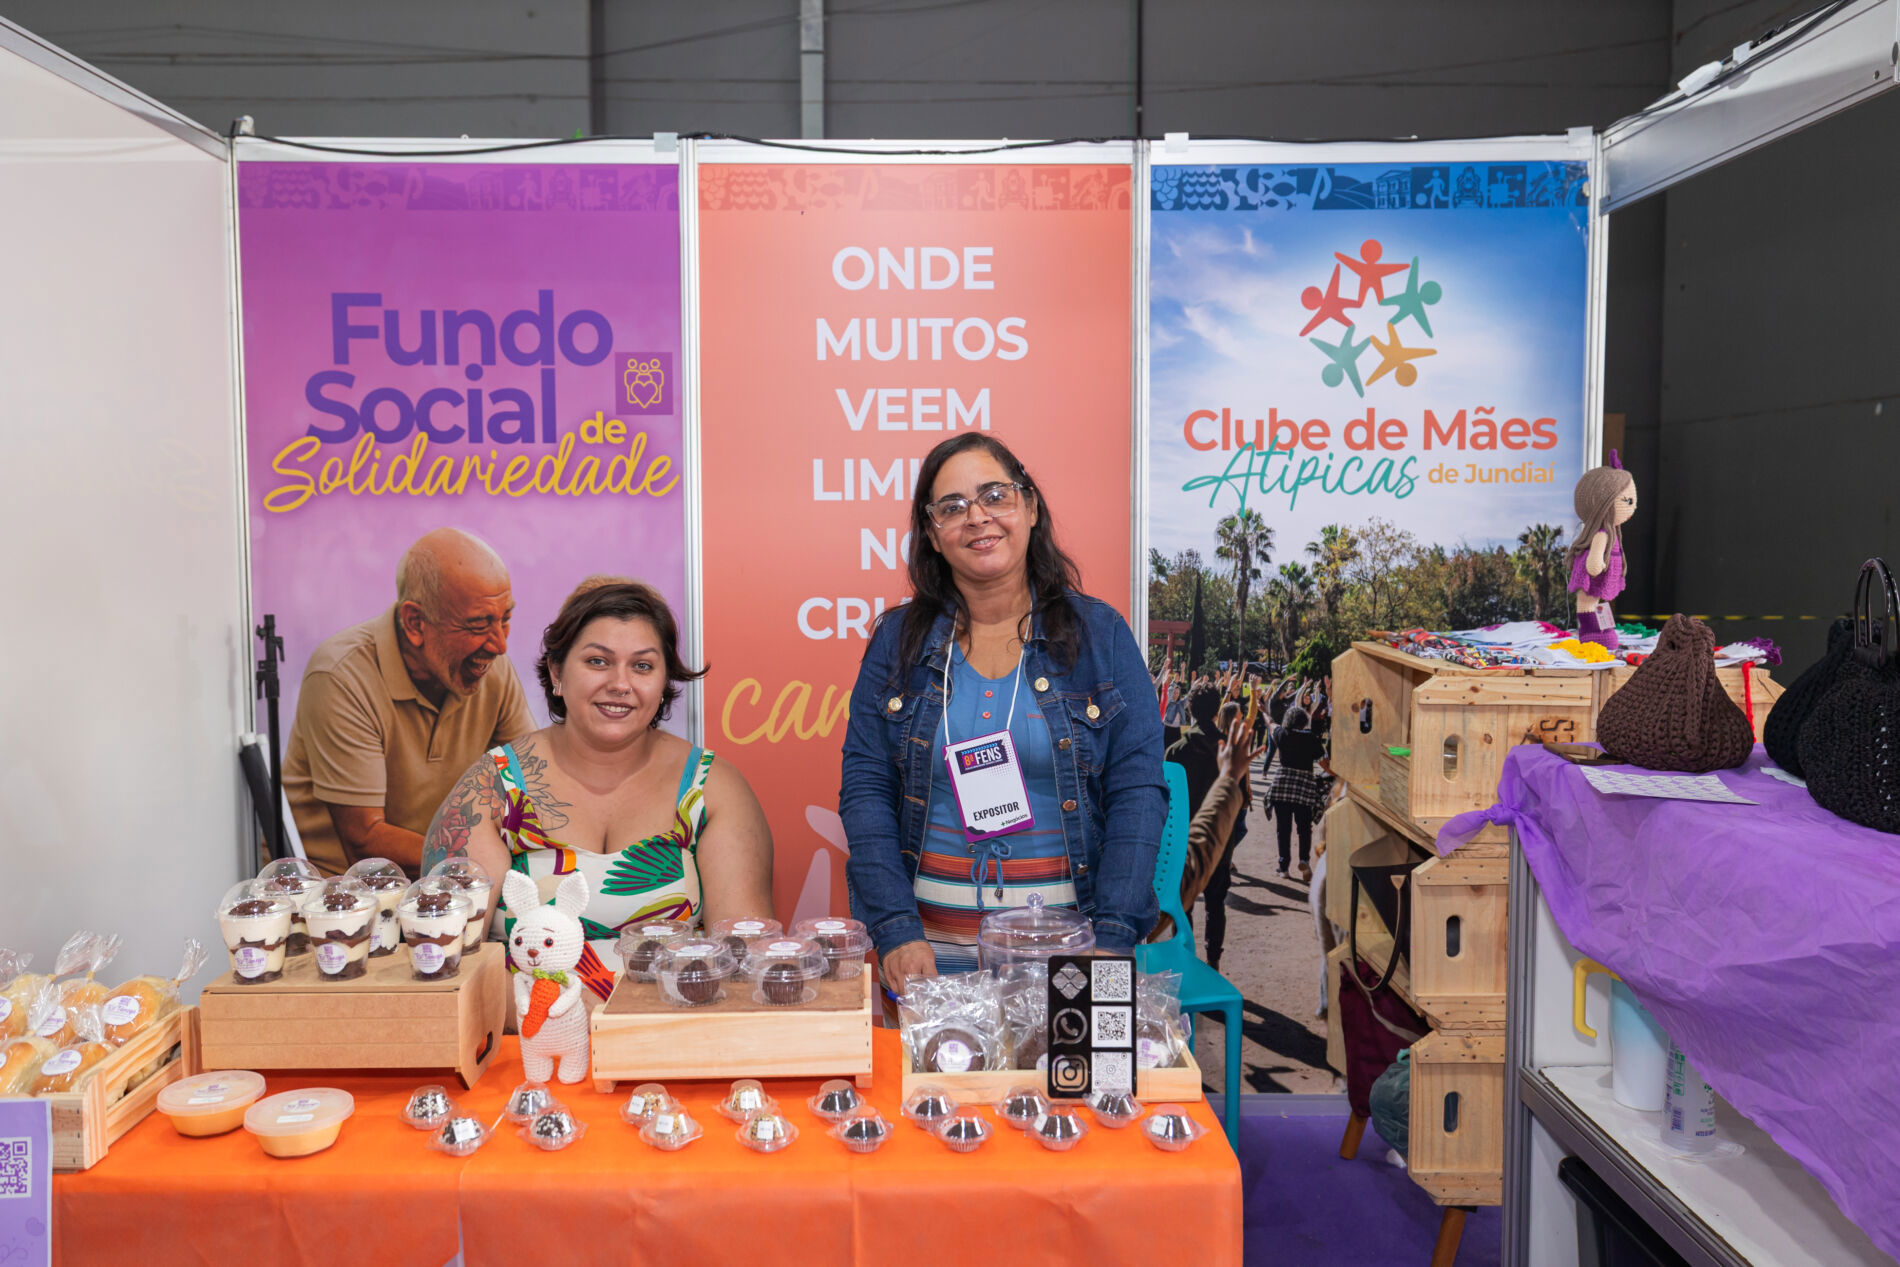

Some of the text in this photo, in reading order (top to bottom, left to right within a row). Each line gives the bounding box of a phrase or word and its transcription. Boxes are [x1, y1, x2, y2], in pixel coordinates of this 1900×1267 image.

[831, 246, 995, 291] ONDE
[331, 288, 614, 367] Fundo
[815, 316, 1029, 361] MUITOS
[304, 363, 557, 444] Social
[835, 388, 992, 431] VEEM
[579, 410, 628, 444] de
[1183, 405, 1559, 451] Clube de Mães
[263, 431, 680, 513] Solidariedade
[812, 458, 925, 501] LIMI
[1428, 463, 1459, 484] de
[1464, 461, 1557, 485] Jundiaí
[974, 746, 1002, 765] FENS
[973, 801, 1020, 821] EXPOSITOR
